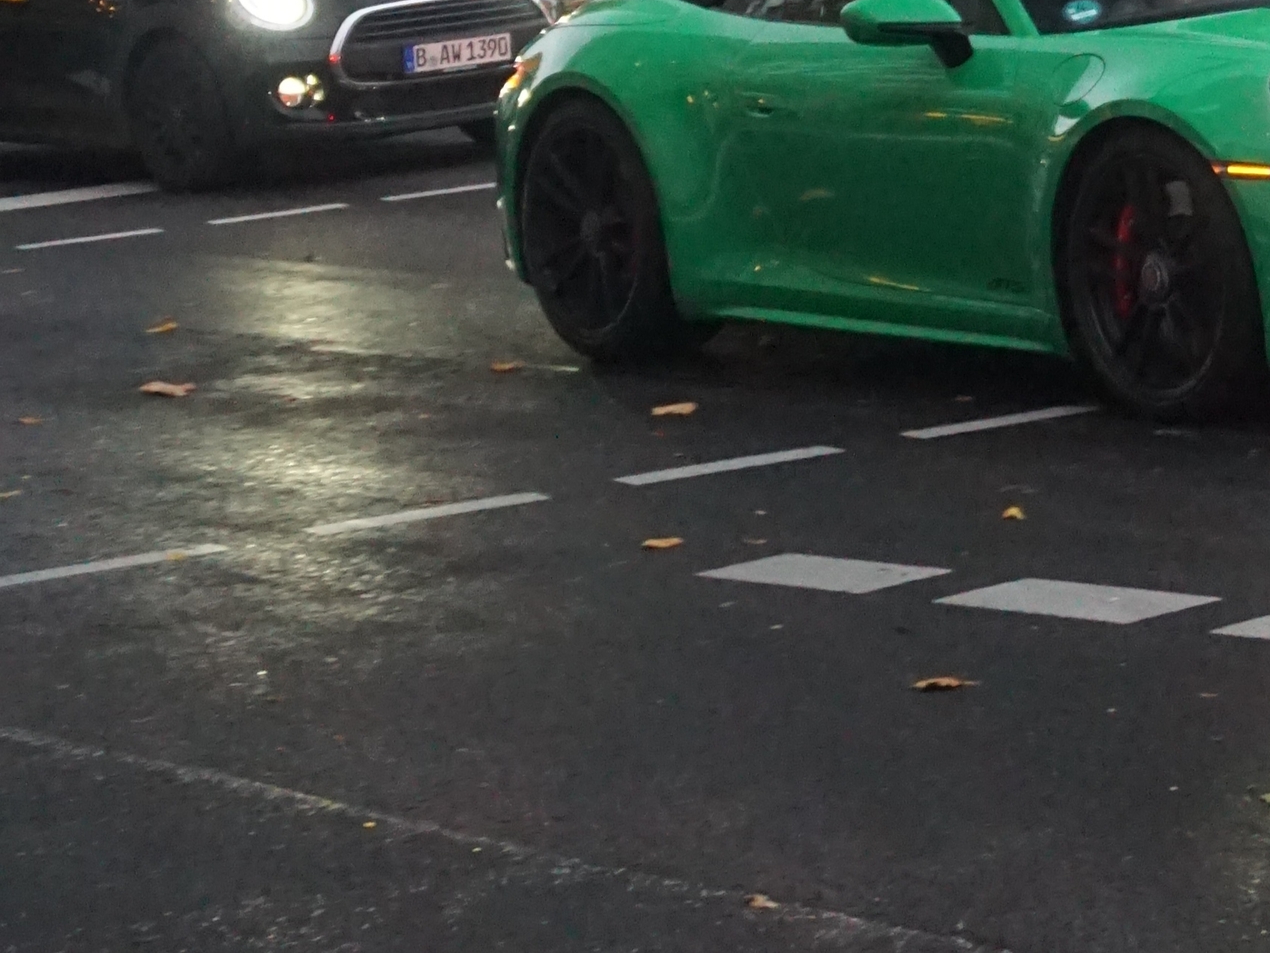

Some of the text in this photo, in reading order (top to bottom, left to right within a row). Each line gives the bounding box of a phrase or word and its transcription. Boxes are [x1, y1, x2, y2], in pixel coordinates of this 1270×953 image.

[416, 37, 508, 67] B AW 1390
